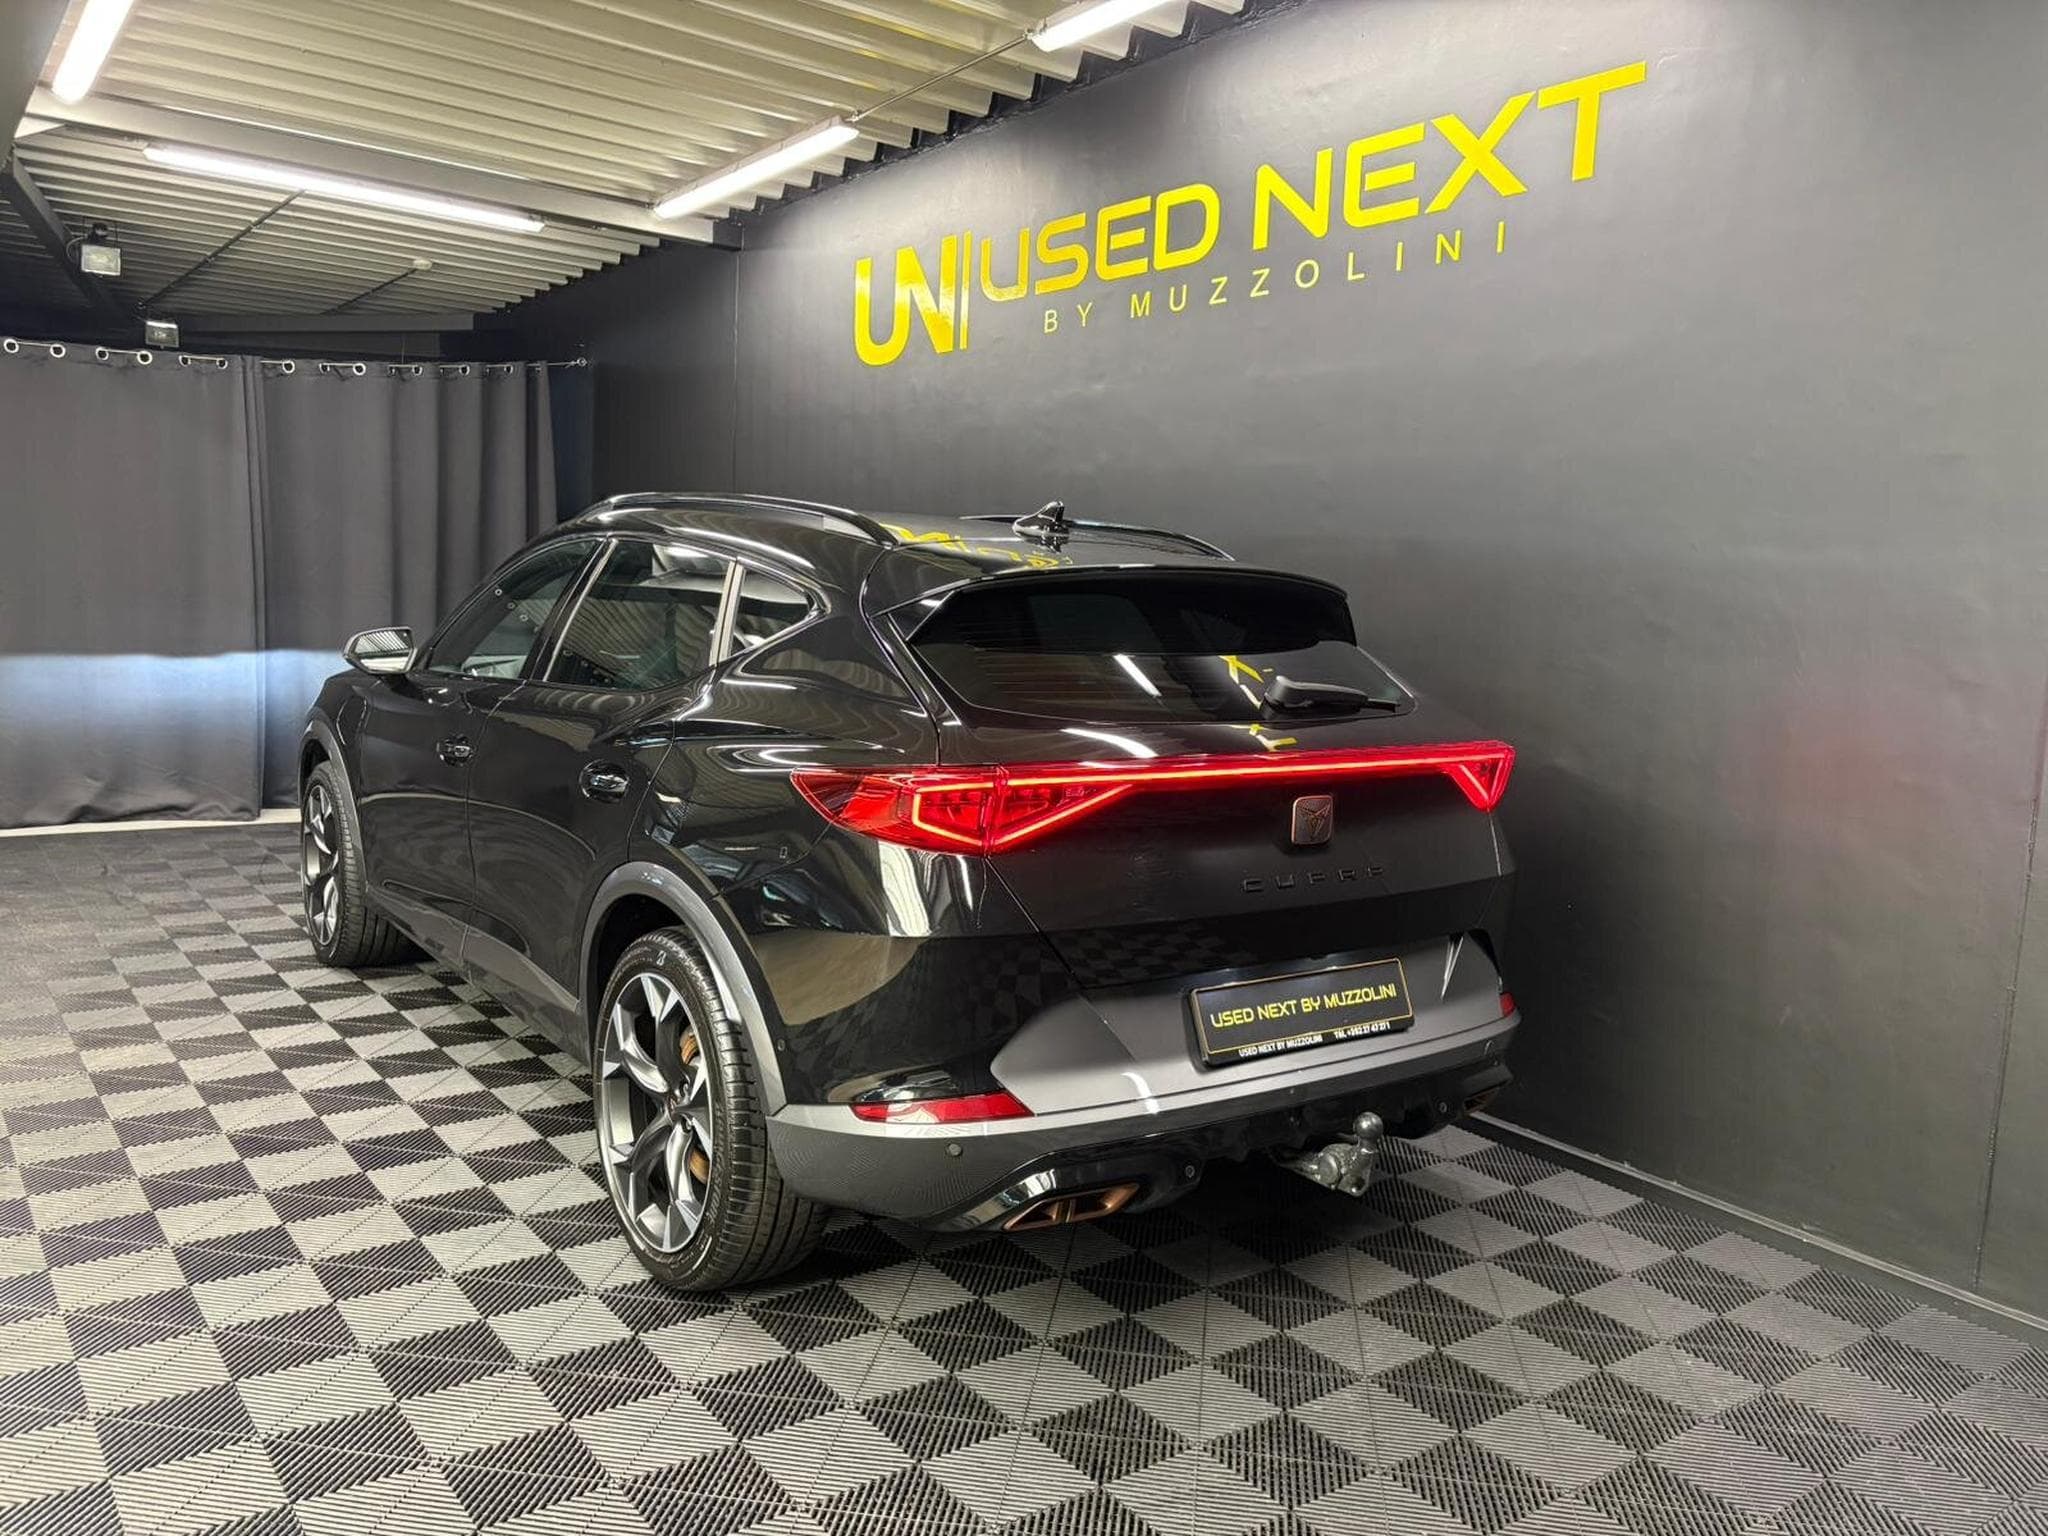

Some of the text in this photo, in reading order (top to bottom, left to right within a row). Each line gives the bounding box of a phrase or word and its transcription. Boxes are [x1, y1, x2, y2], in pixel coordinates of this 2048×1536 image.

[980, 61, 1647, 302] USED NEXT
[1043, 220, 1508, 334] BY MUZZOLINI
[1242, 866, 1384, 893] CUPRA
[1210, 983, 1397, 1028] USED NEXT BY MUZZOLINI
[1238, 1046, 1258, 1057] USED
